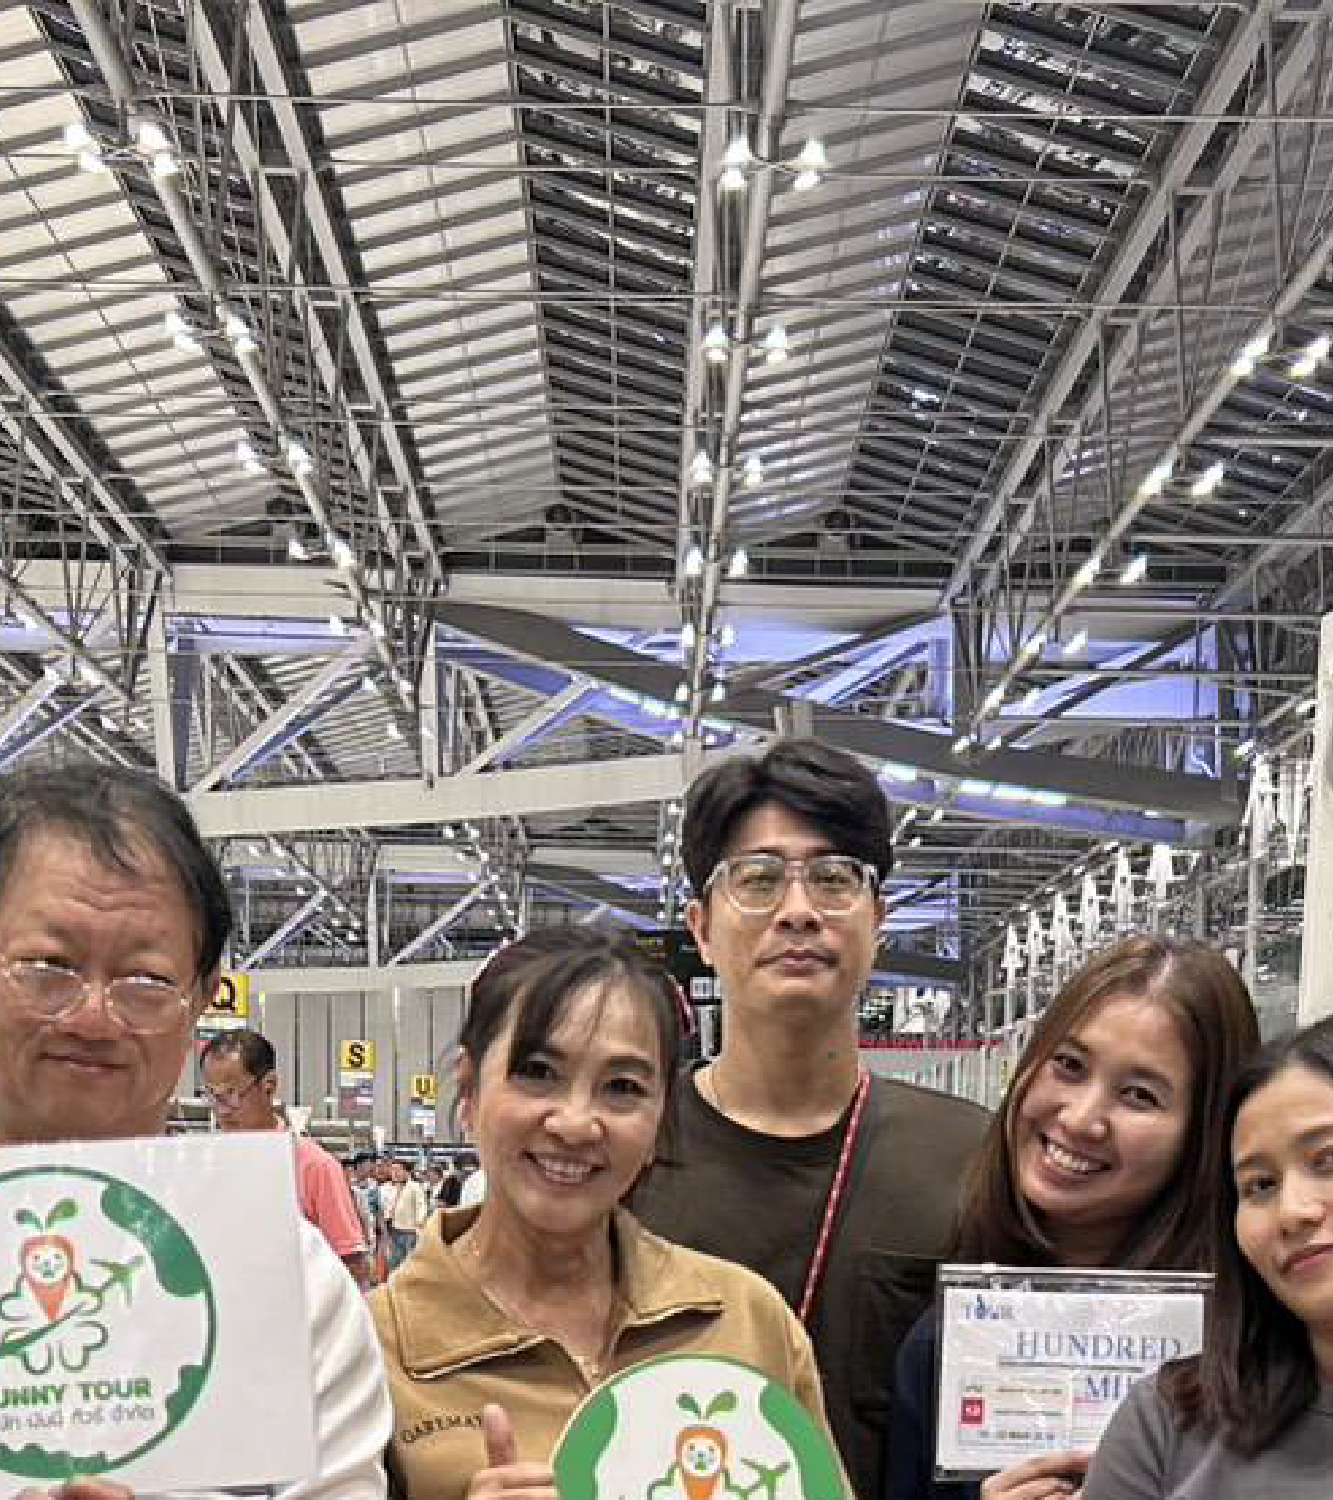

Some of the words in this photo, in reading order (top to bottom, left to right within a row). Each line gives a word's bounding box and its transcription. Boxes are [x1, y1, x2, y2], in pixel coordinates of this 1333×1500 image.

[212, 976, 236, 1010] Q
[348, 1042, 366, 1068] S
[1017, 1331, 1182, 1361] HUNDRED
[76, 1378, 151, 1401] TOUR
